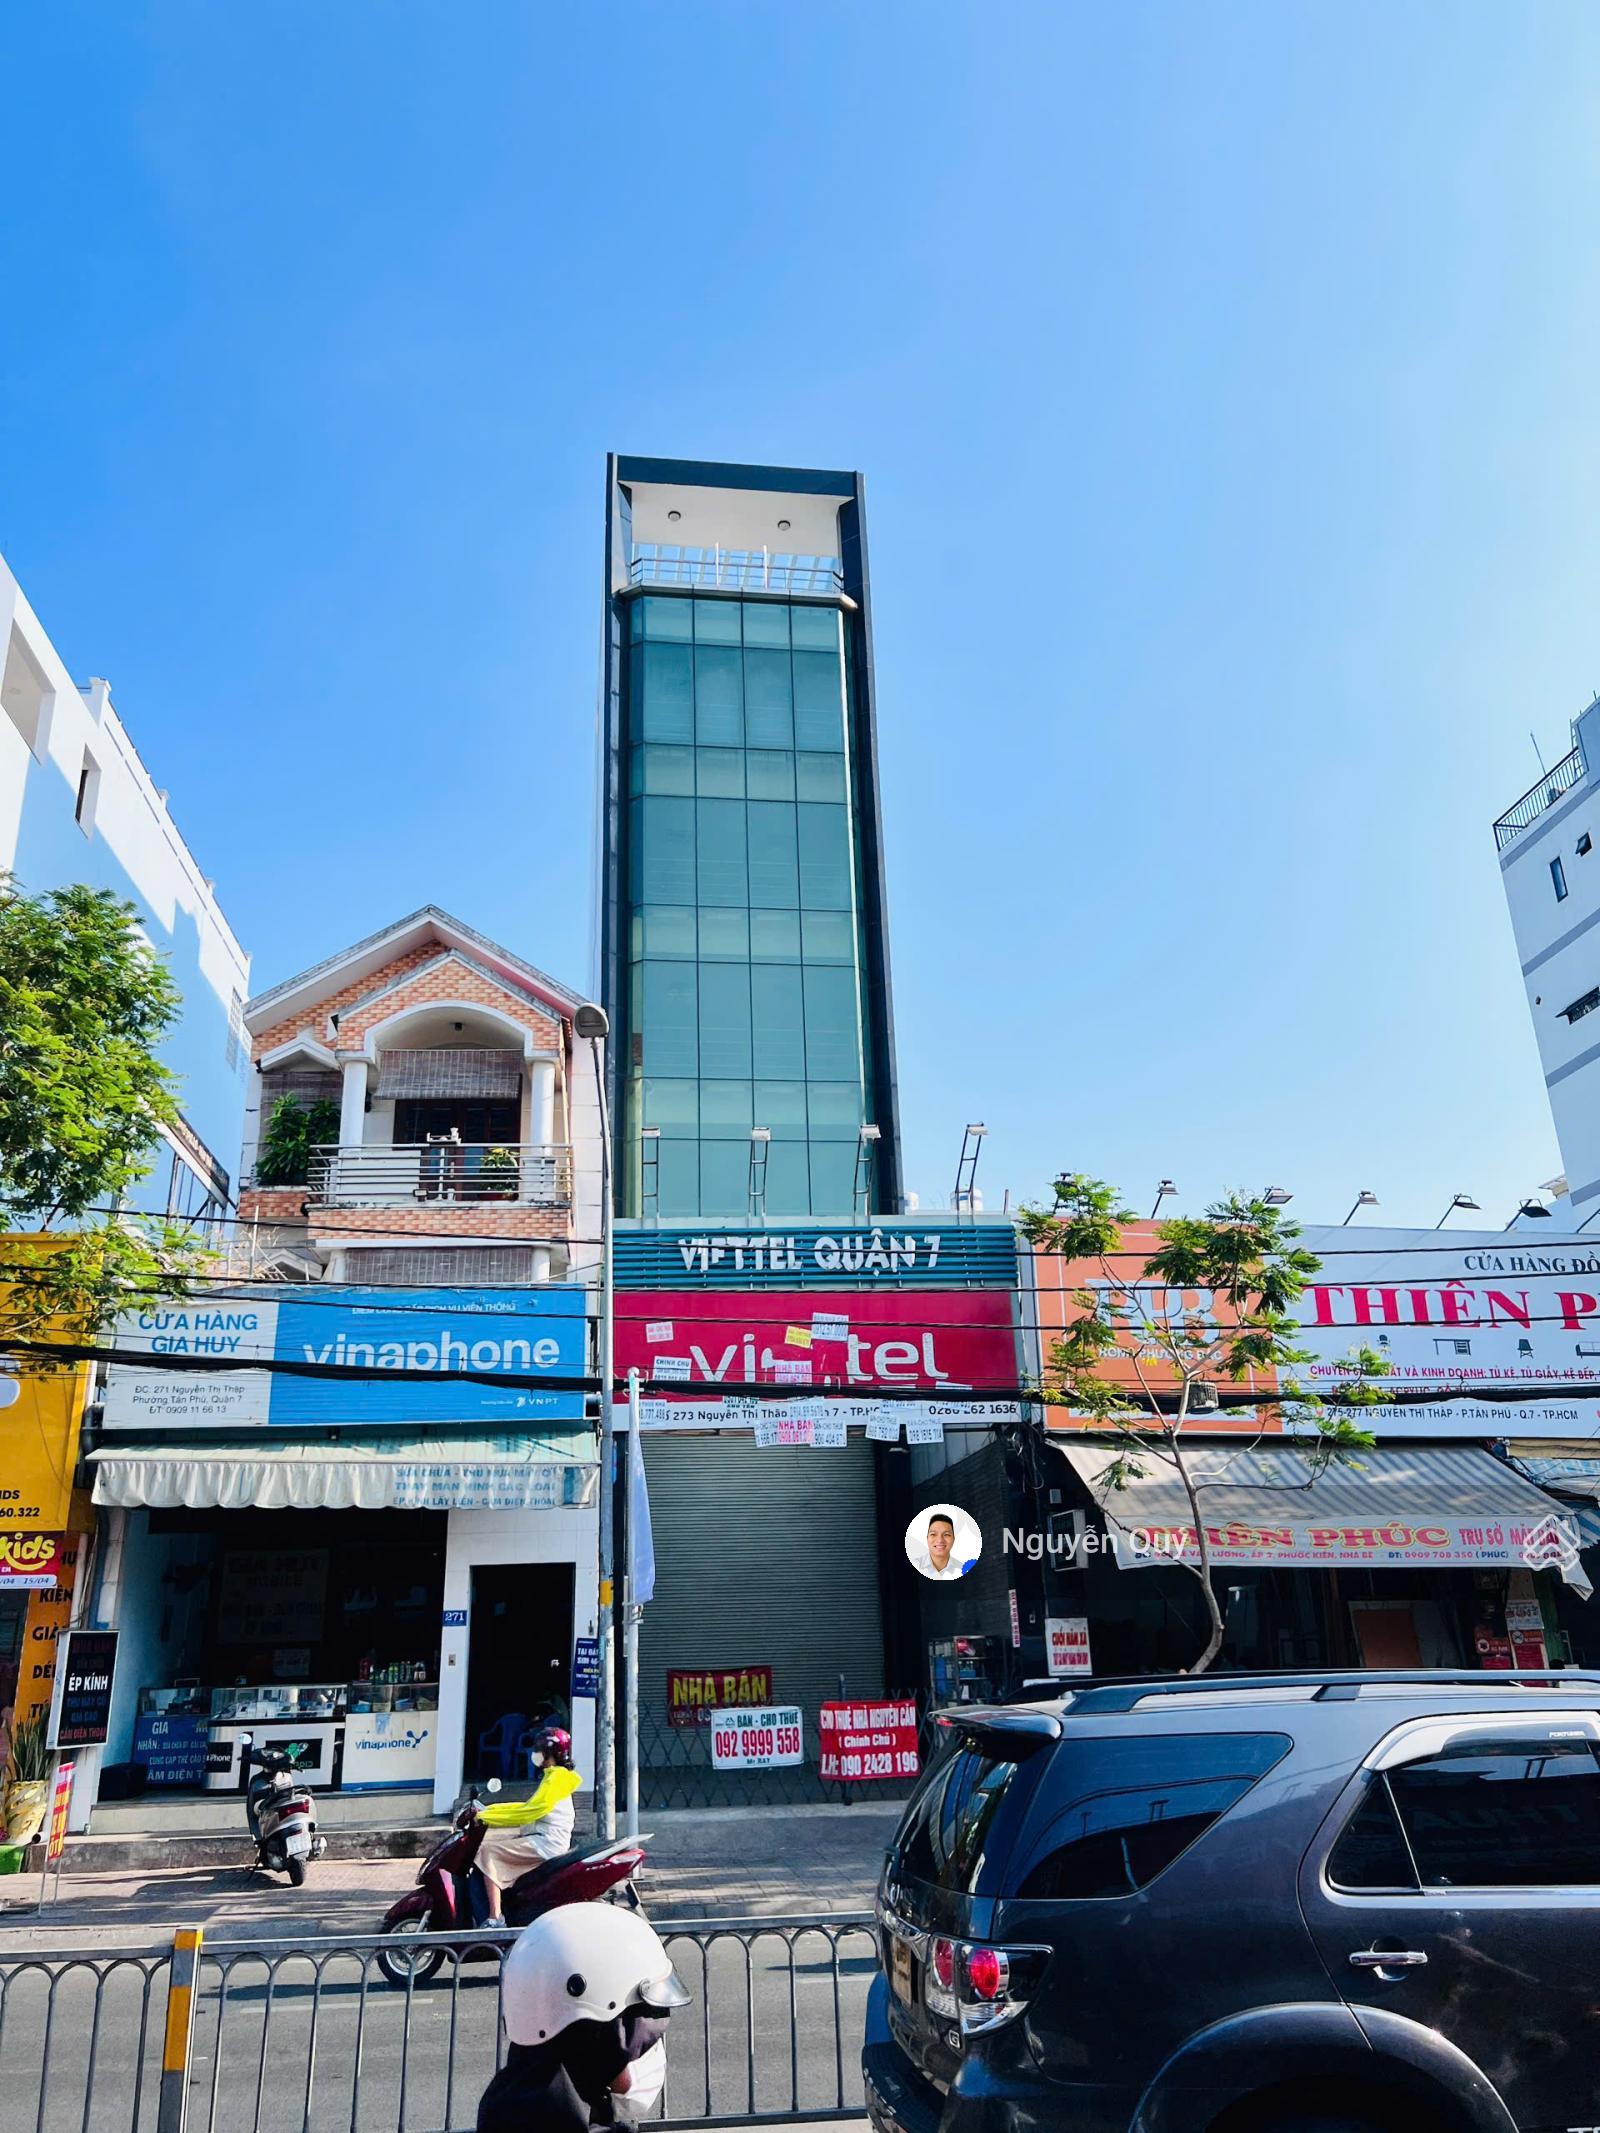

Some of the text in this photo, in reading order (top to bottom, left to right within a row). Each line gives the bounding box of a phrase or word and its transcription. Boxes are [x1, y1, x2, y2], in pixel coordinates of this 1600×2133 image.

[924, 1235, 941, 1268] 7
[1464, 1251, 1504, 1271] CỬA
[1511, 1252, 1566, 1273] HÀNG
[1302, 1280, 1600, 1331] THIÊN P
[139, 1310, 258, 1330] CỬA HÀNG
[151, 1336, 241, 1353] GIA HUY
[303, 1331, 560, 1373] vinaphone
[1422, 1367, 1445, 1377] KINH
[154, 1385, 169, 1394] 271
[166, 1406, 188, 1414] 0909
[217, 1405, 226, 1413] 13
[673, 1411, 694, 1421] 273
[832, 1407, 840, 1417] 7
[989, 1404, 1017, 1414] 1636
[1520, 1409, 1534, 1420] Q.7
[1543, 1409, 1579, 1420] TP.HCM
[1305, 1520, 1452, 1549] PHÚC
[1404, 1551, 1430, 1559] 0909
[444, 1612, 465, 1622] 271
[68, 1671, 109, 1692] ÉP KÍNH
[673, 1669, 767, 1706] NHÀ BÁN
[761, 1713, 777, 1727] CHO
[152, 1721, 169, 1735] GIA
[715, 1727, 800, 1758] 092 9999 558
[840, 1754, 862, 1776] 090
[864, 1752, 893, 1775] 2428
[895, 1751, 918, 1773] 196
